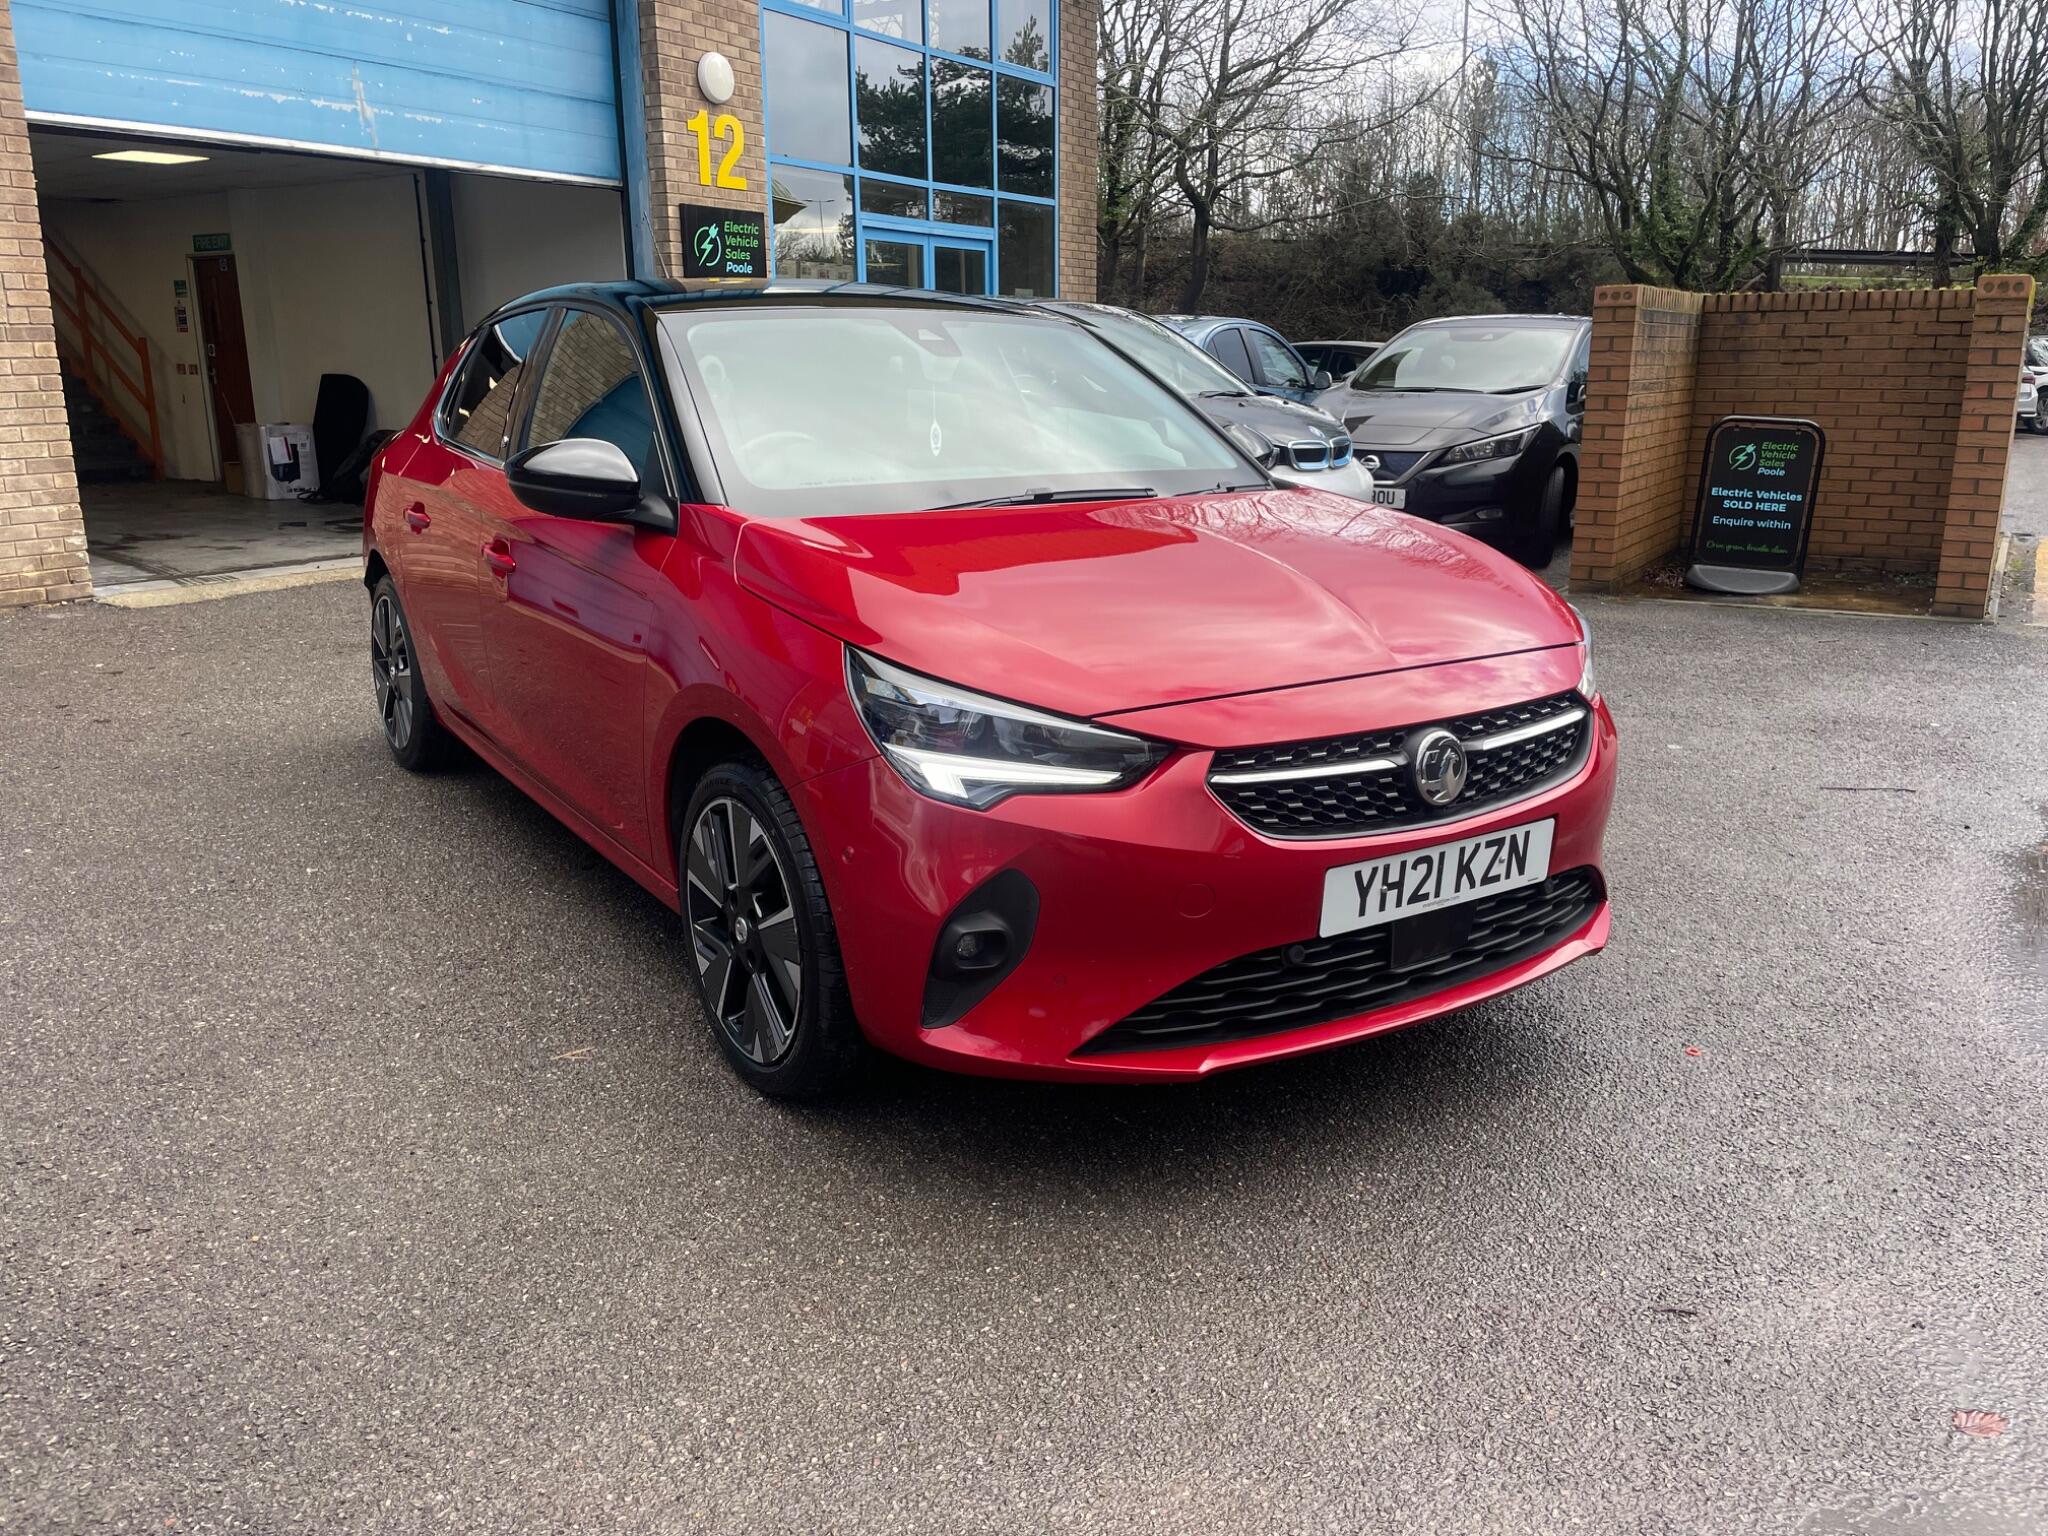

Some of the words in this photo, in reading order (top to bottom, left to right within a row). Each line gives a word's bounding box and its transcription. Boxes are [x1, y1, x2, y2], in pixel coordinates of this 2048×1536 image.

[687, 109, 748, 191] 12
[723, 221, 759, 234] Electric
[724, 235, 759, 248] Vehicle
[724, 248, 751, 260] Sales
[726, 261, 753, 274] Poole
[1761, 441, 1799, 451] Electric
[1761, 450, 1796, 460] Vehicle
[1758, 459, 1785, 467] Sales
[1757, 467, 1786, 476] Poole
[1711, 487, 1753, 498] Electric
[1756, 490, 1803, 501] Vehicles
[1723, 500, 1753, 510] SOLD
[1755, 502, 1787, 512] HERE
[1712, 515, 1754, 527] Enquire
[1756, 519, 1791, 530] within
[1354, 850, 1446, 917] YH21
[1454, 830, 1531, 894] KZN
